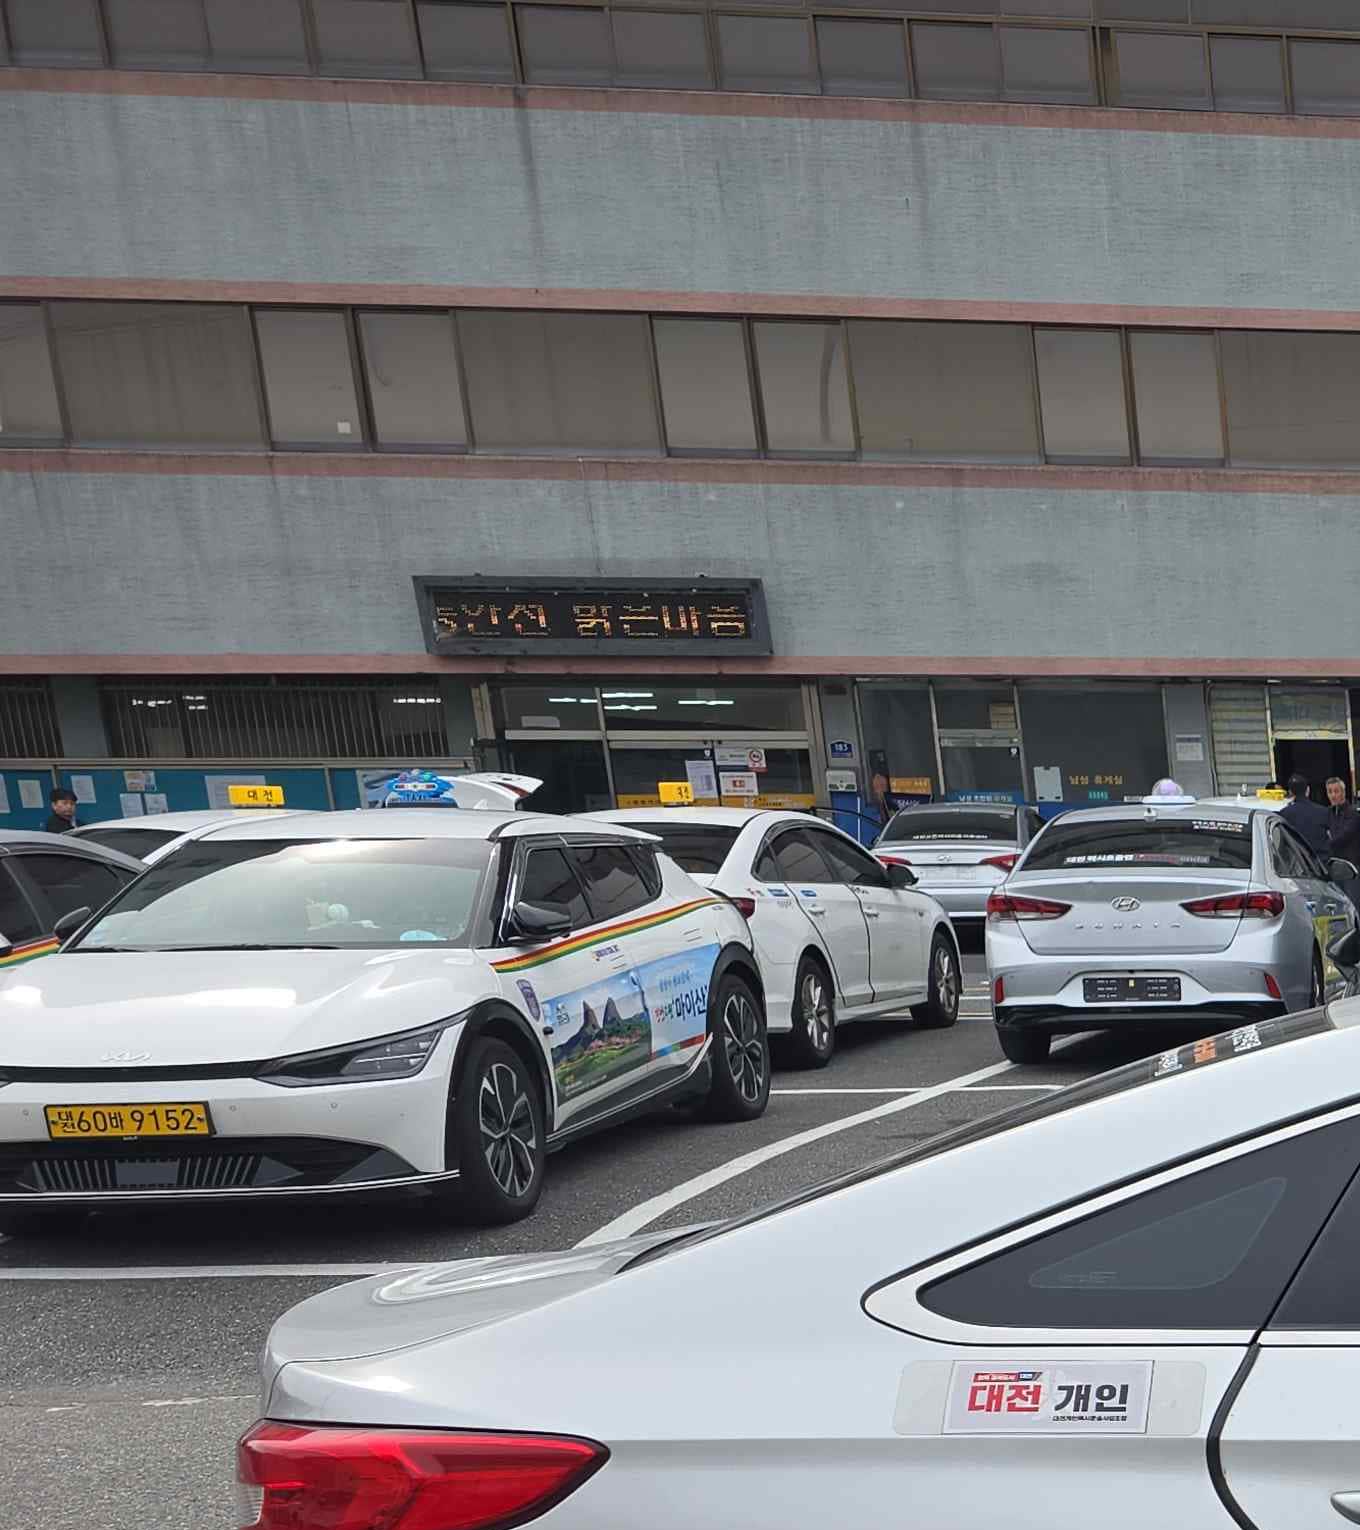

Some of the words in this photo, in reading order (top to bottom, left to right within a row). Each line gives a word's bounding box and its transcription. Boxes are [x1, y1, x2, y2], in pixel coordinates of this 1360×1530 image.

[130, 1108, 197, 1132] 9152
[967, 1384, 1042, 1413] 대전
[1054, 1384, 1129, 1413] 개인
